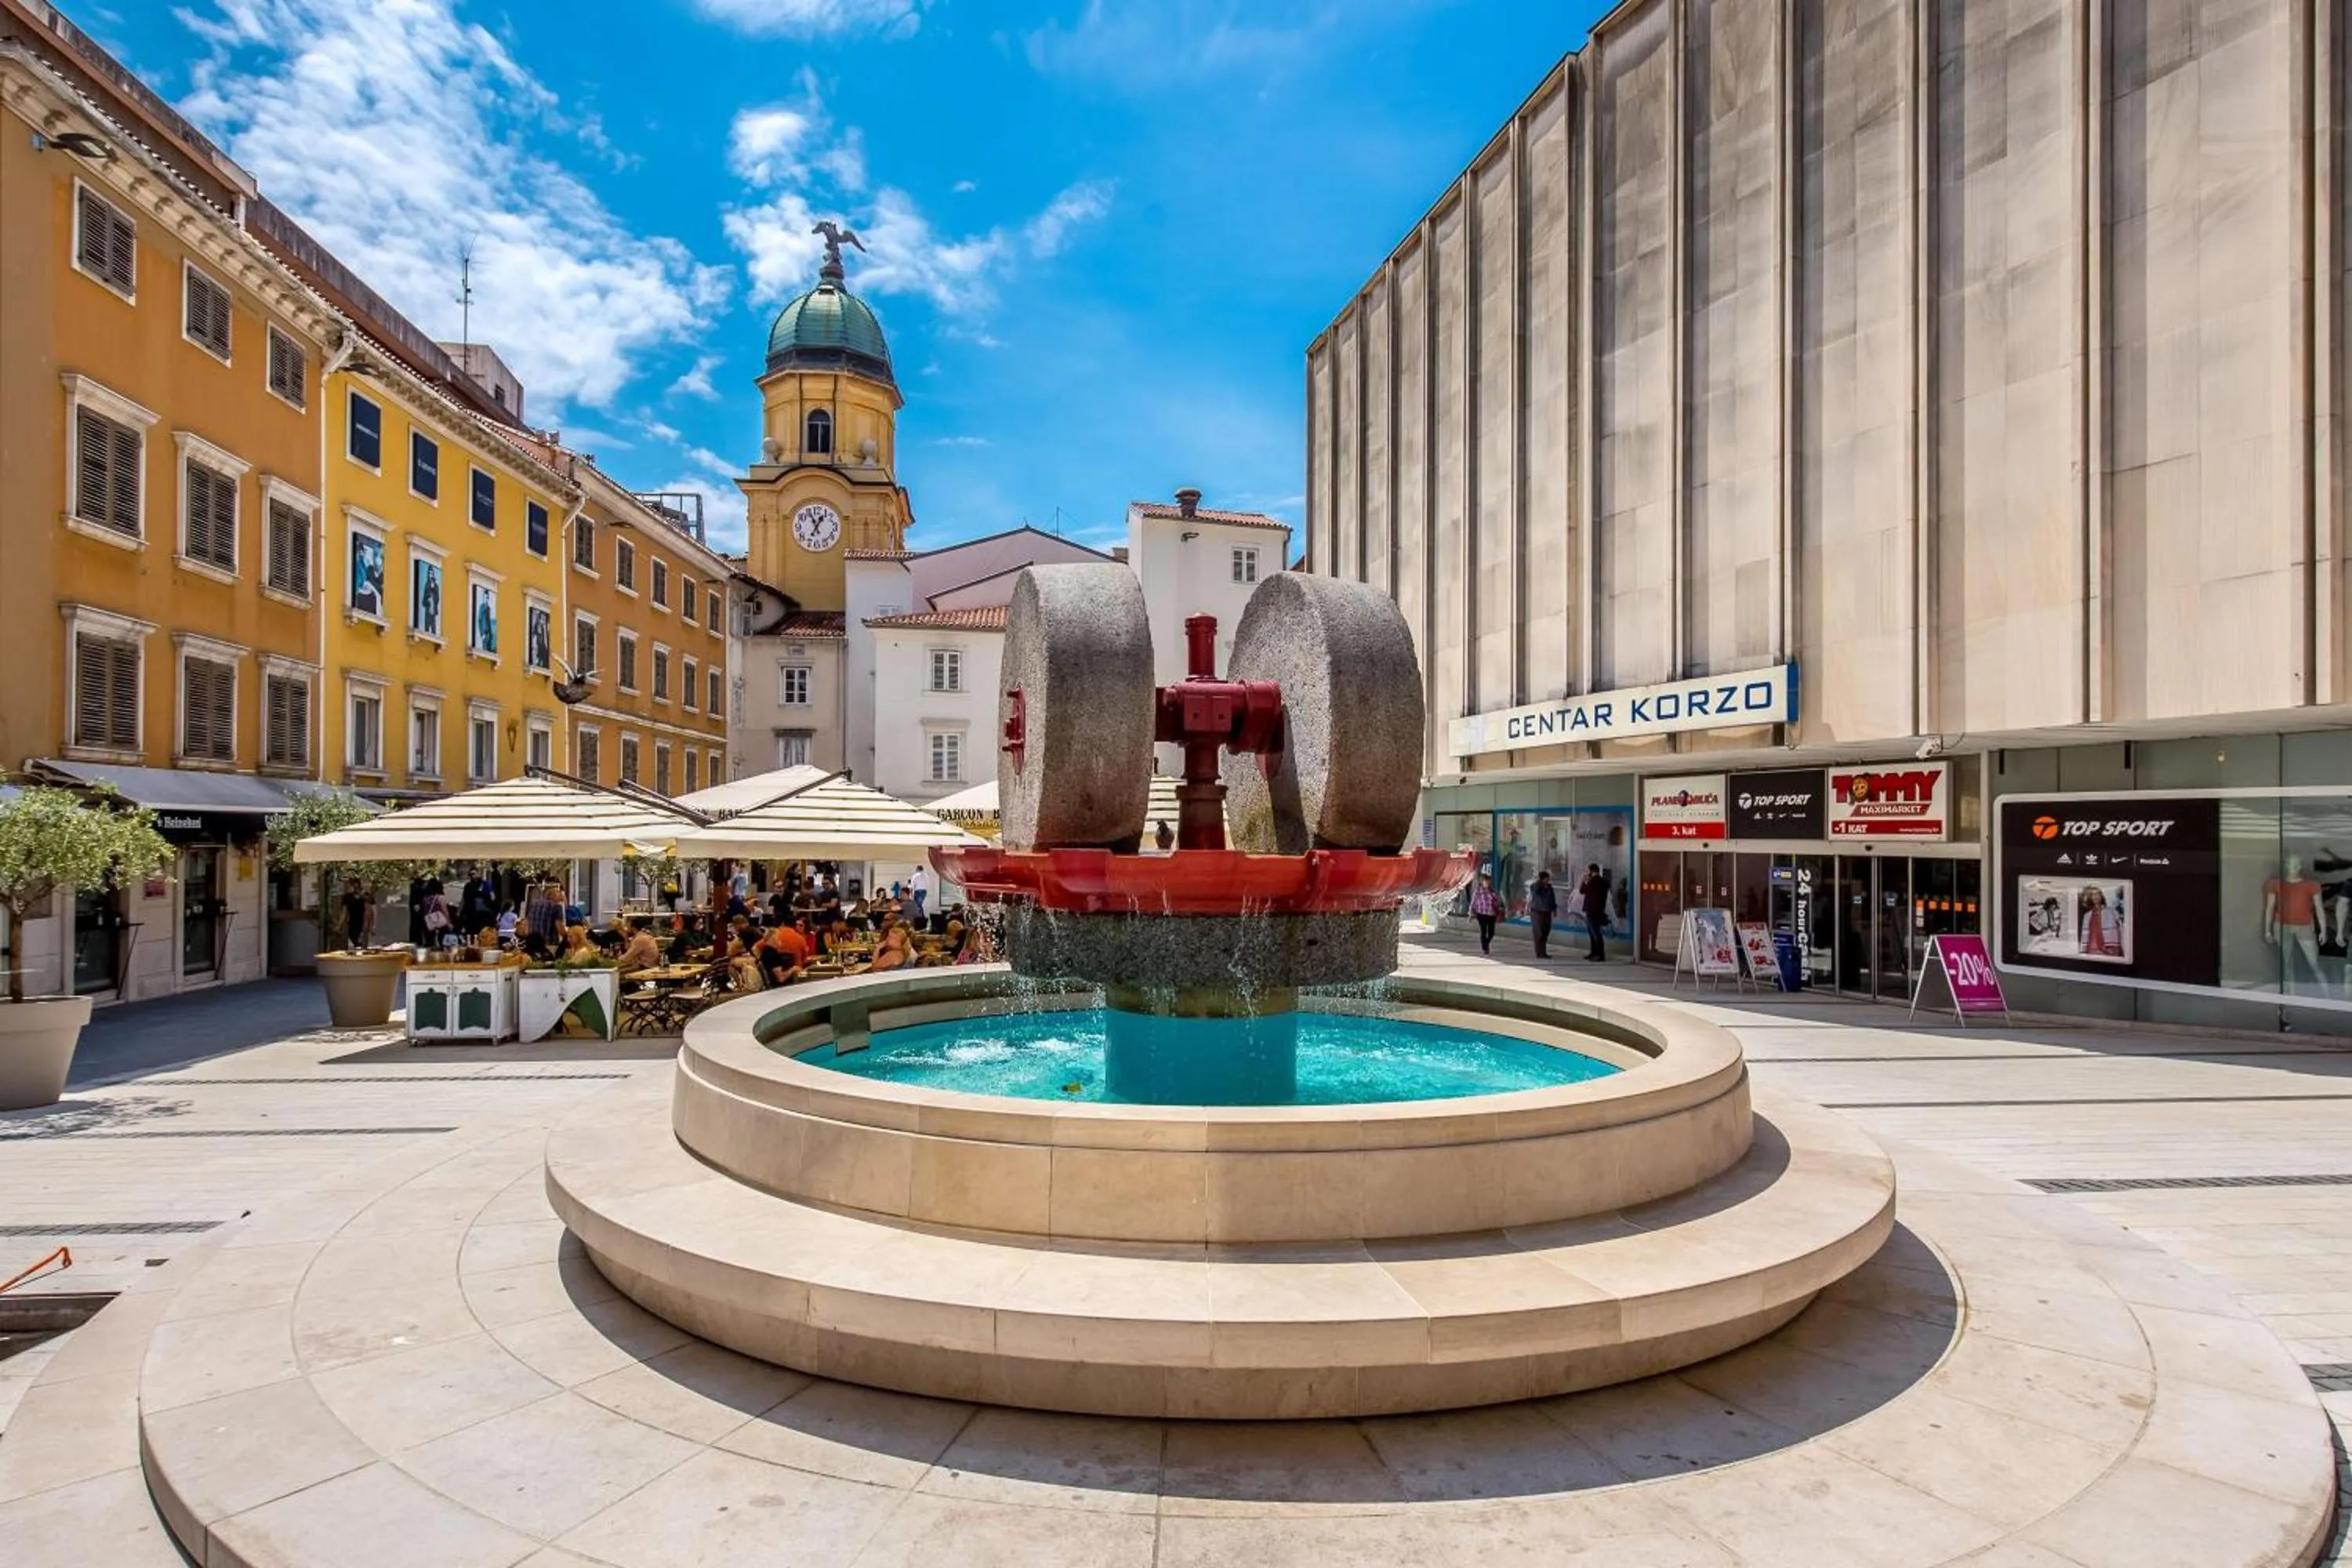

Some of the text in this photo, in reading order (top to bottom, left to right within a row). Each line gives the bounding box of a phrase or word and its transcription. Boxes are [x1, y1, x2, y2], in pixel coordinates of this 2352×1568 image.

[1508, 681, 1772, 739] CENTAR KORZO
[1754, 793, 1812, 807] TOP SPORT
[1860, 805, 1922, 815] MAXIMARKET
[1671, 826, 1697, 835] 3. kat
[1834, 822, 1867, 833] -1 KAT
[2061, 820, 2175, 837] TOP SPORT
[1797, 868, 1812, 895] 24
[1949, 952, 1994, 986] -20%
